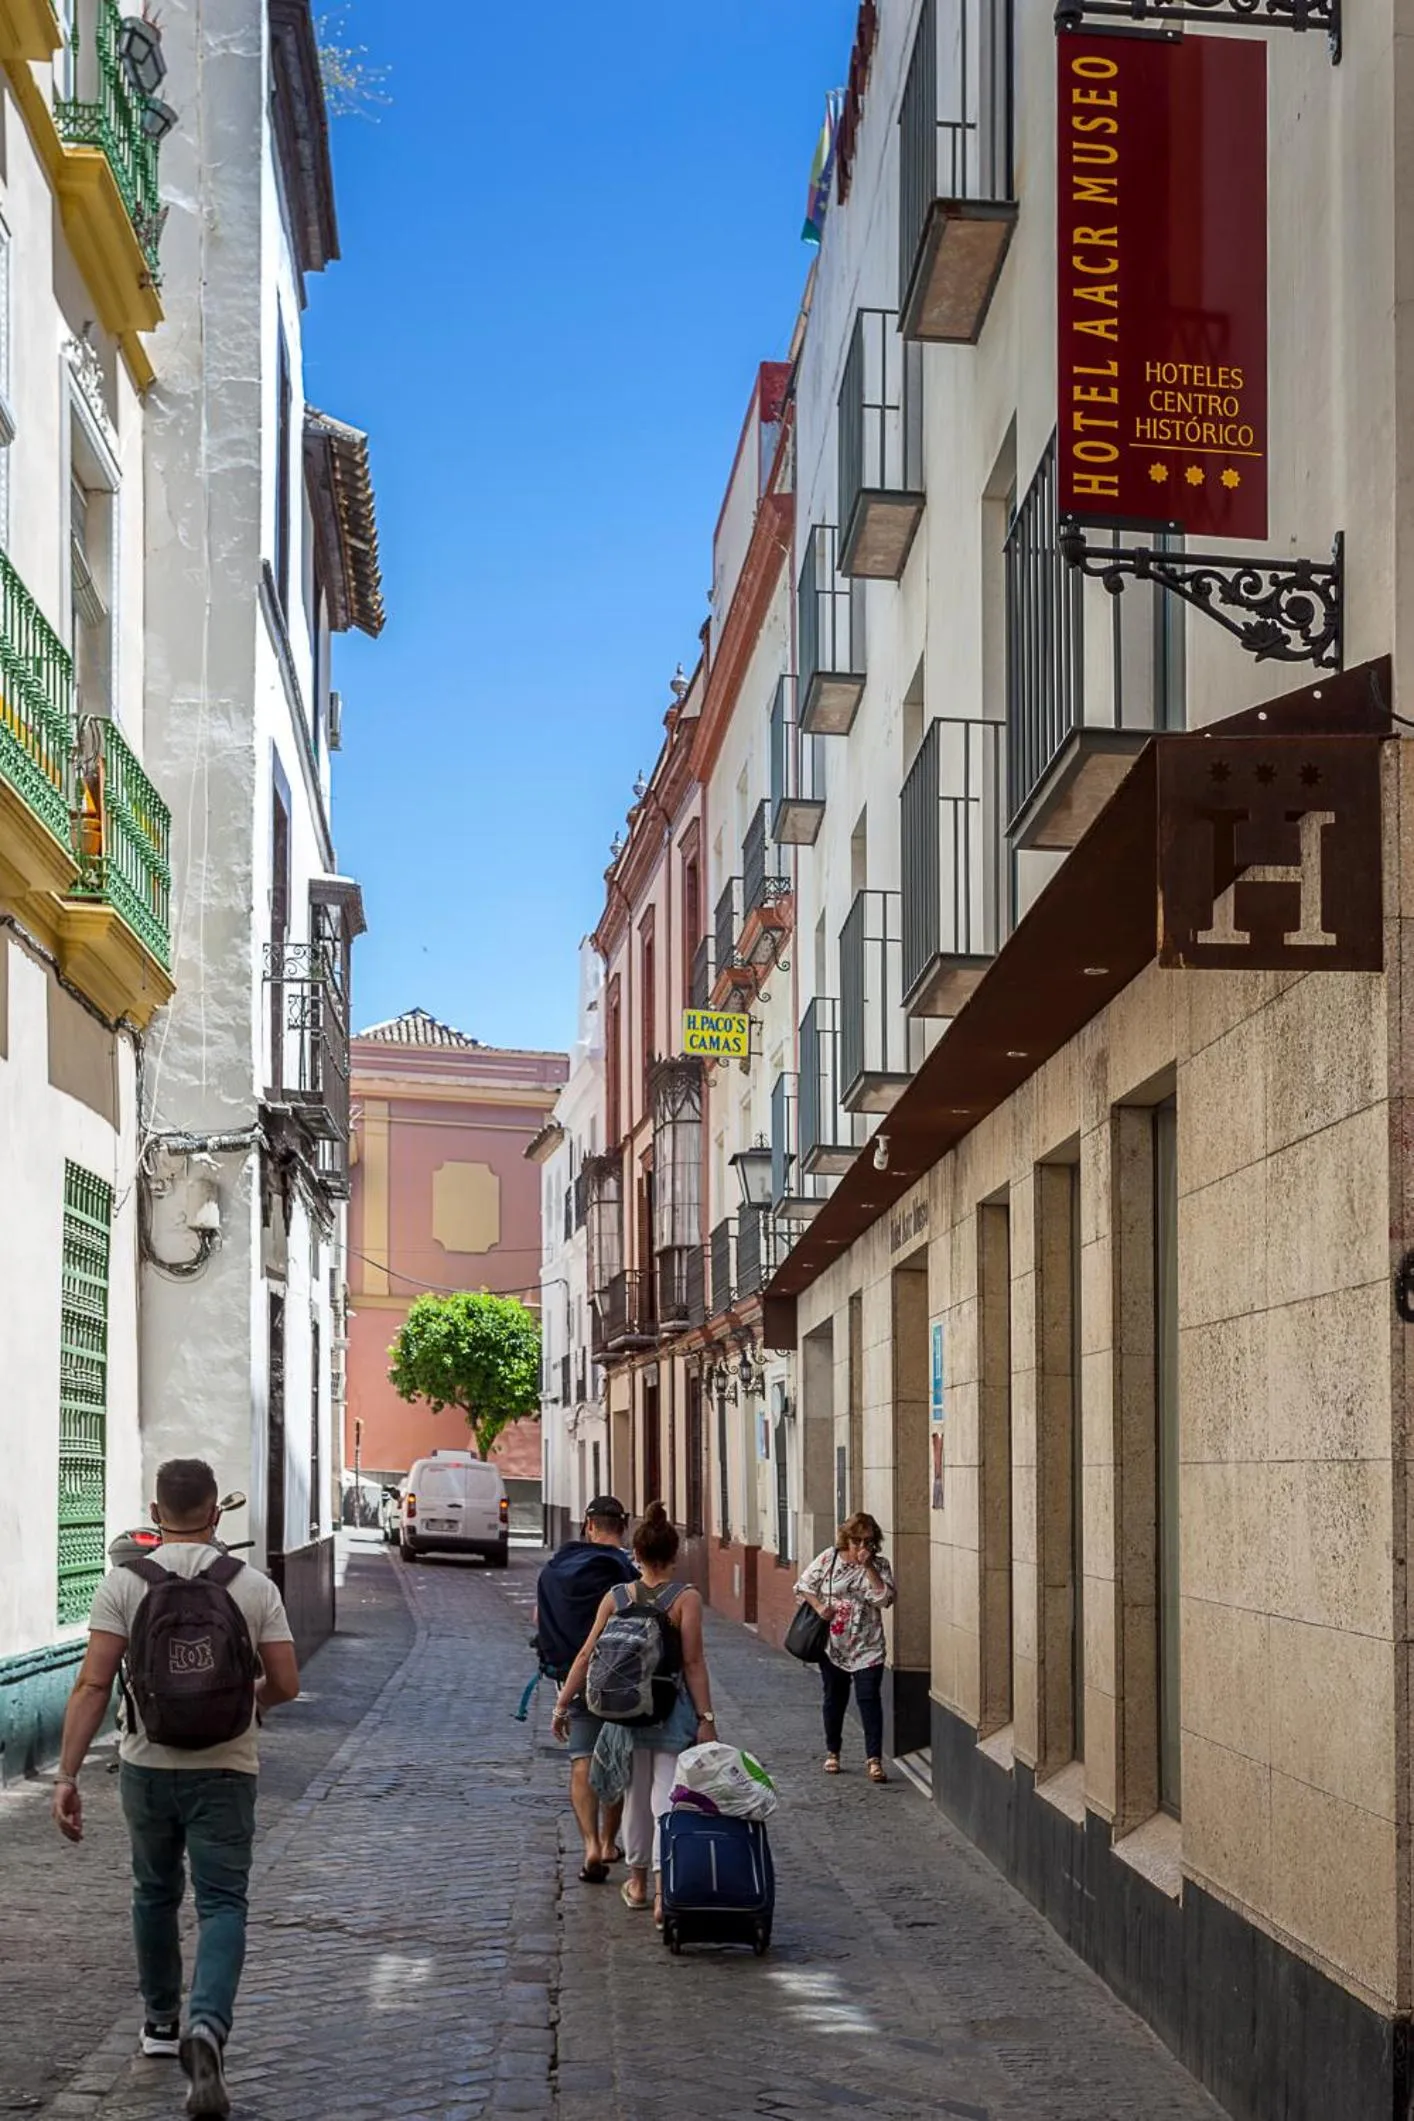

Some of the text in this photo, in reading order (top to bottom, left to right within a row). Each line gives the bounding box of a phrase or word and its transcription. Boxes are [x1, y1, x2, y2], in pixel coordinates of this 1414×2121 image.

[1071, 56, 1119, 497] HOTEL AACR MUSEO
[1145, 361, 1243, 389] HOTELES
[1149, 390, 1240, 417] CENTRO
[1135, 414, 1255, 447] HISTÓRICO
[1197, 809, 1337, 946] H
[689, 1034, 742, 1053] CAMAS
